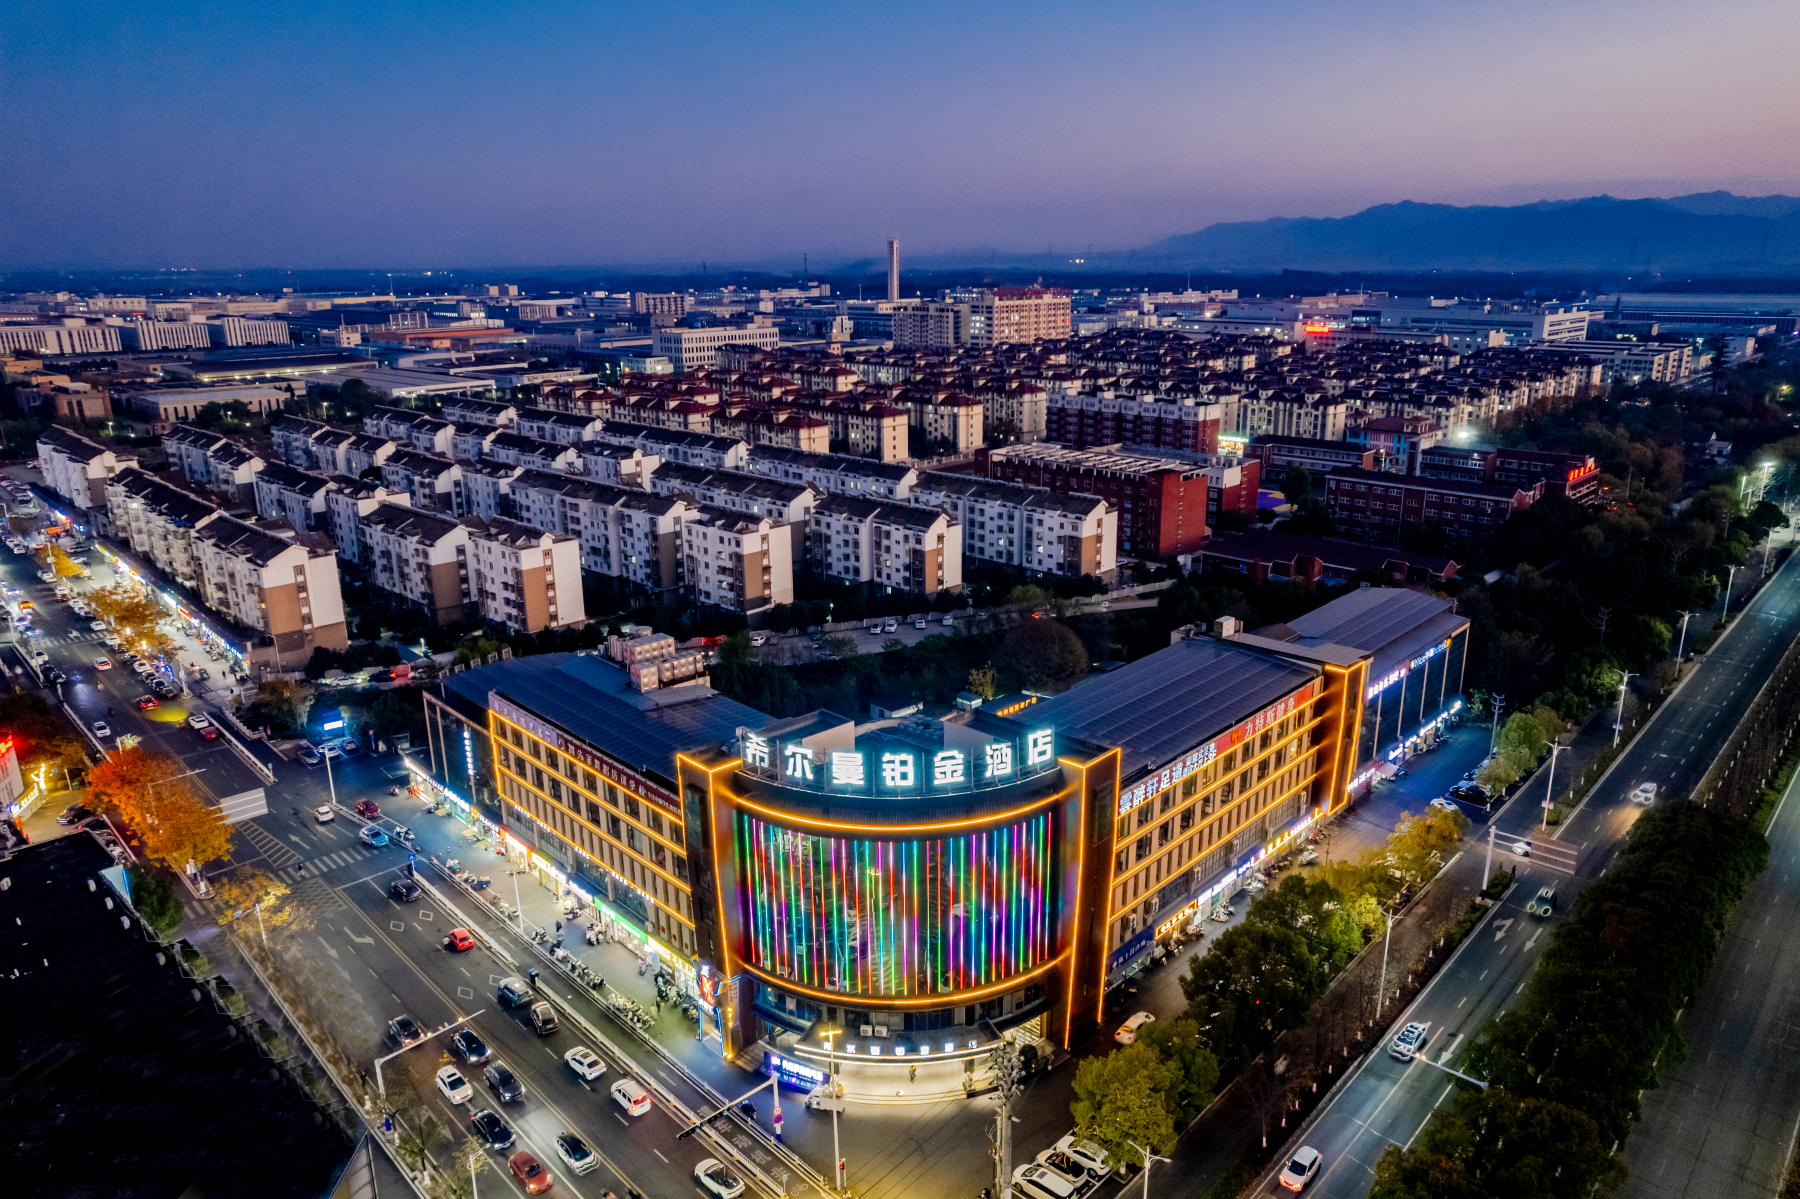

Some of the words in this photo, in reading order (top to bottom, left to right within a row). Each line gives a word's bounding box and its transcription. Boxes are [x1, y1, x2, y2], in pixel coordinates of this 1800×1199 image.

[745, 729, 1052, 786] 希尔曼铂金酒店
